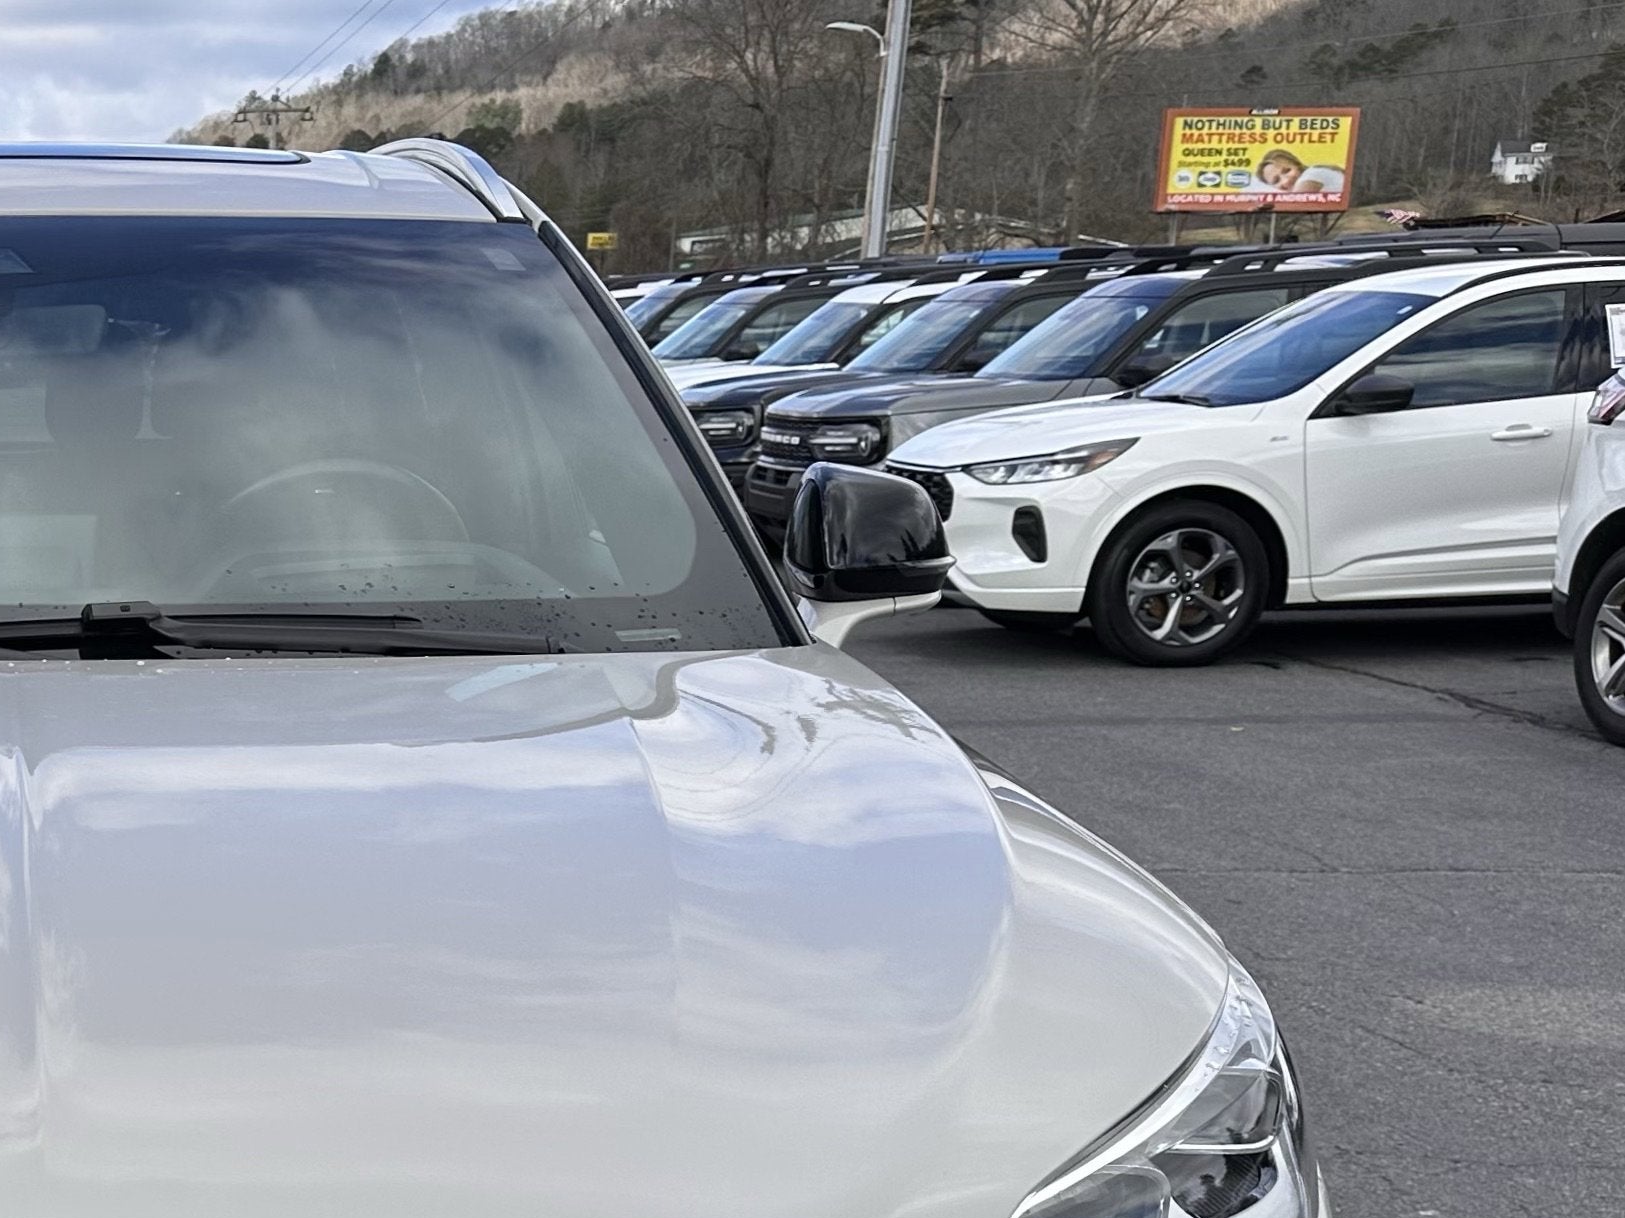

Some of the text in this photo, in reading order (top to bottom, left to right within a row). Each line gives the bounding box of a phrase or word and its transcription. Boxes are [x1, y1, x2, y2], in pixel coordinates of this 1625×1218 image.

[1182, 118, 1340, 131] NOTHING BUT BEDS
[1180, 132, 1338, 144] MATTRESS OUTLET
[1182, 147, 1248, 157] QUEEN SET
[1177, 160, 1211, 169] Starting
[1223, 158, 1251, 168] $499
[1167, 194, 1212, 203] LOCATED
[1213, 194, 1224, 202] IN
[1225, 193, 1265, 202] MURPHY
[1327, 193, 1342, 202] NC
